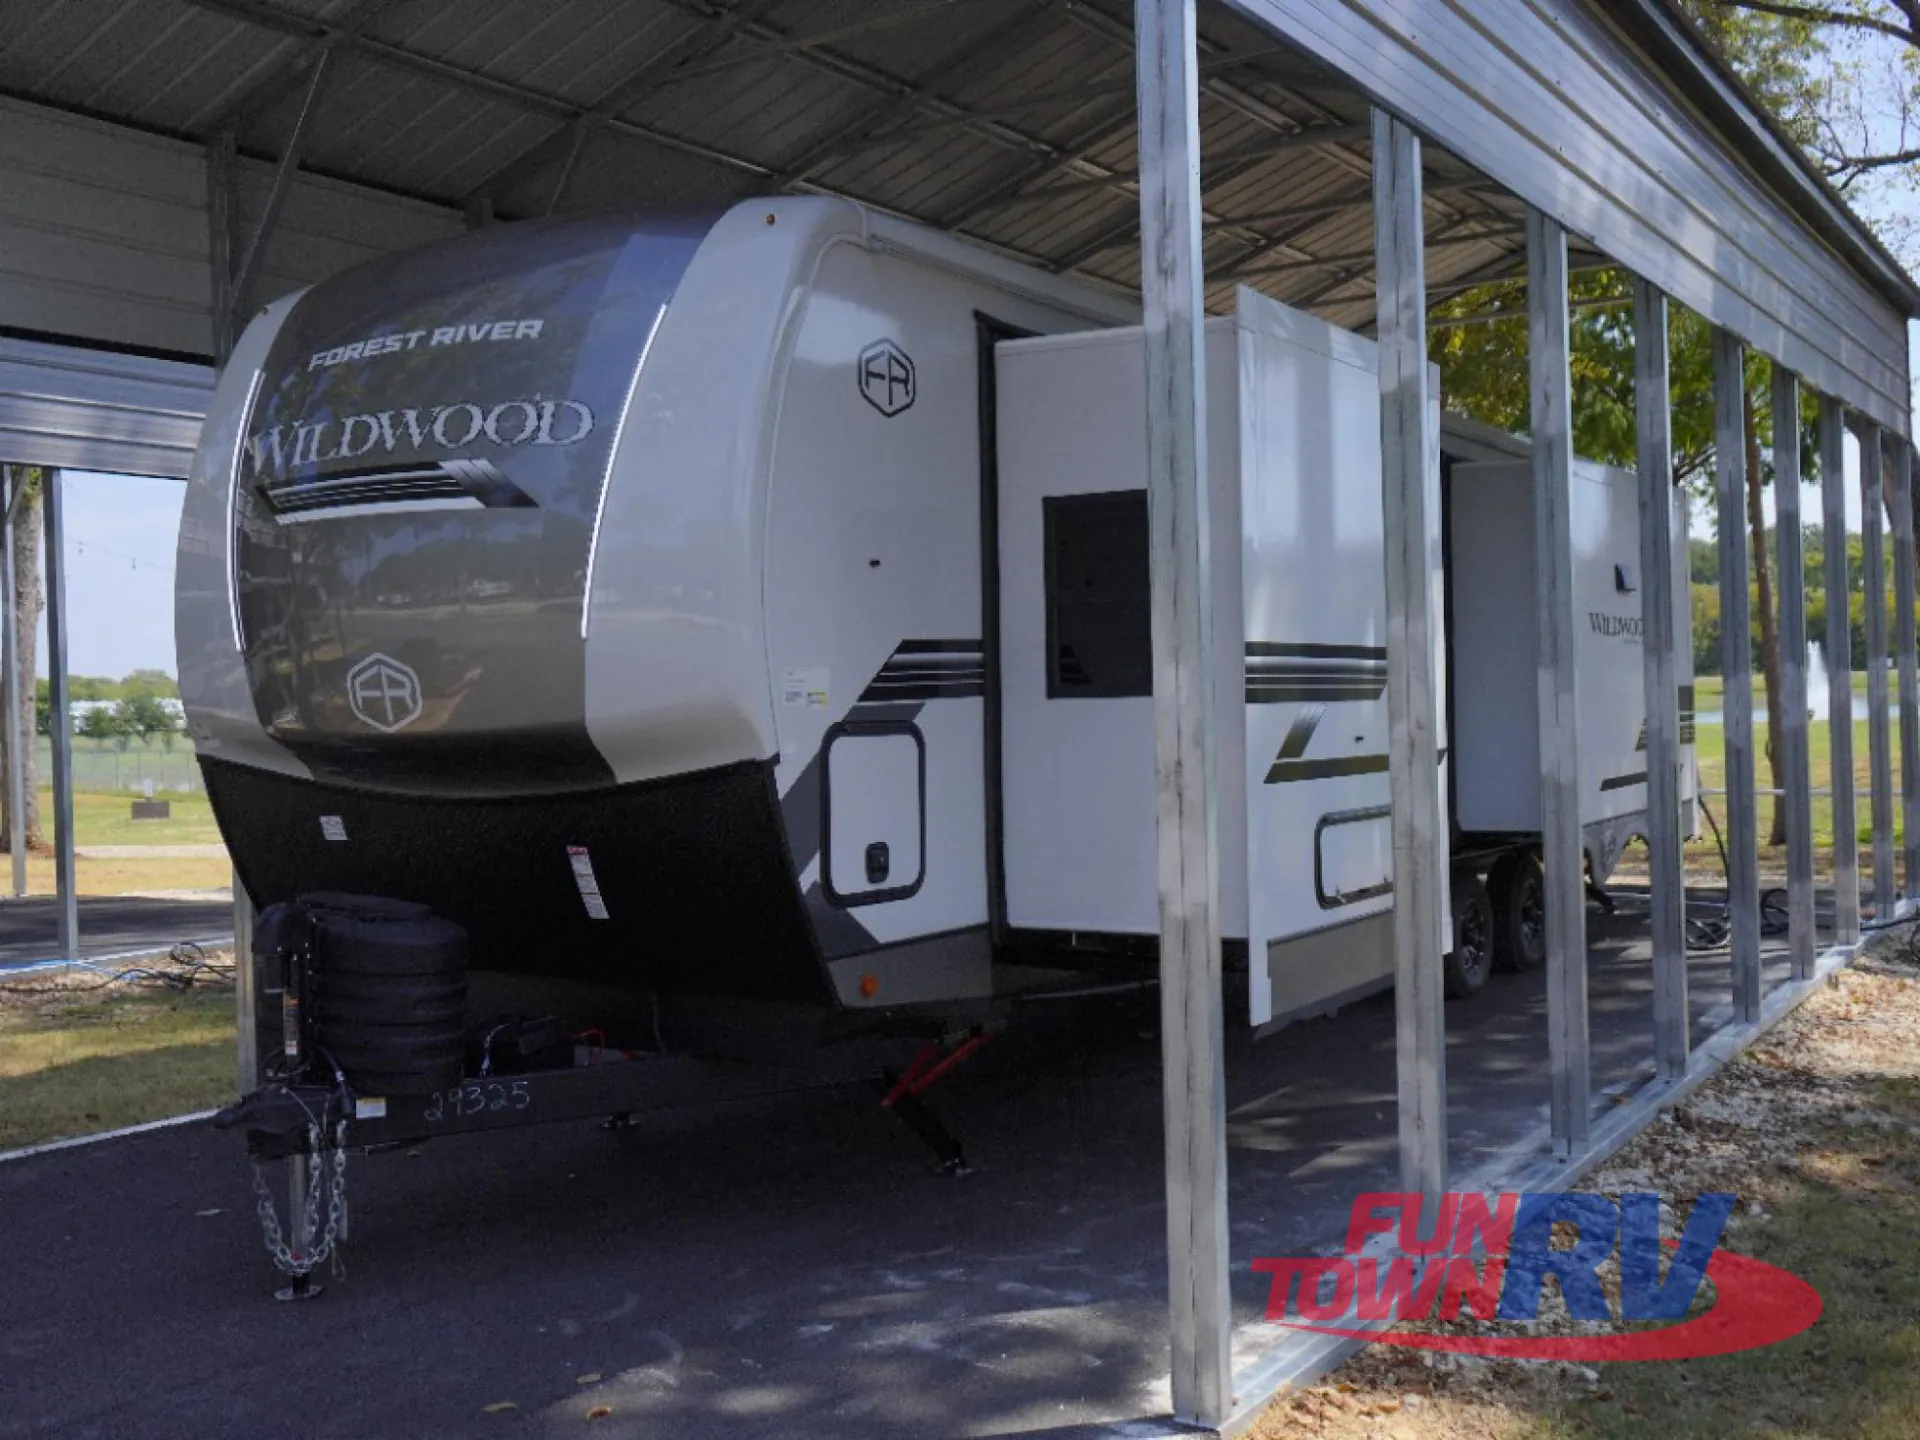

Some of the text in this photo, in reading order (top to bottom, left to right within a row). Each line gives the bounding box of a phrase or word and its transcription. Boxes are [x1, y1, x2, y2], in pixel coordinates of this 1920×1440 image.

[307, 320, 544, 372] FOREST RIVER
[250, 399, 595, 477] WILDWOOD
[1588, 611, 1645, 637] WILDWOO
[424, 1081, 530, 1120] 29325
